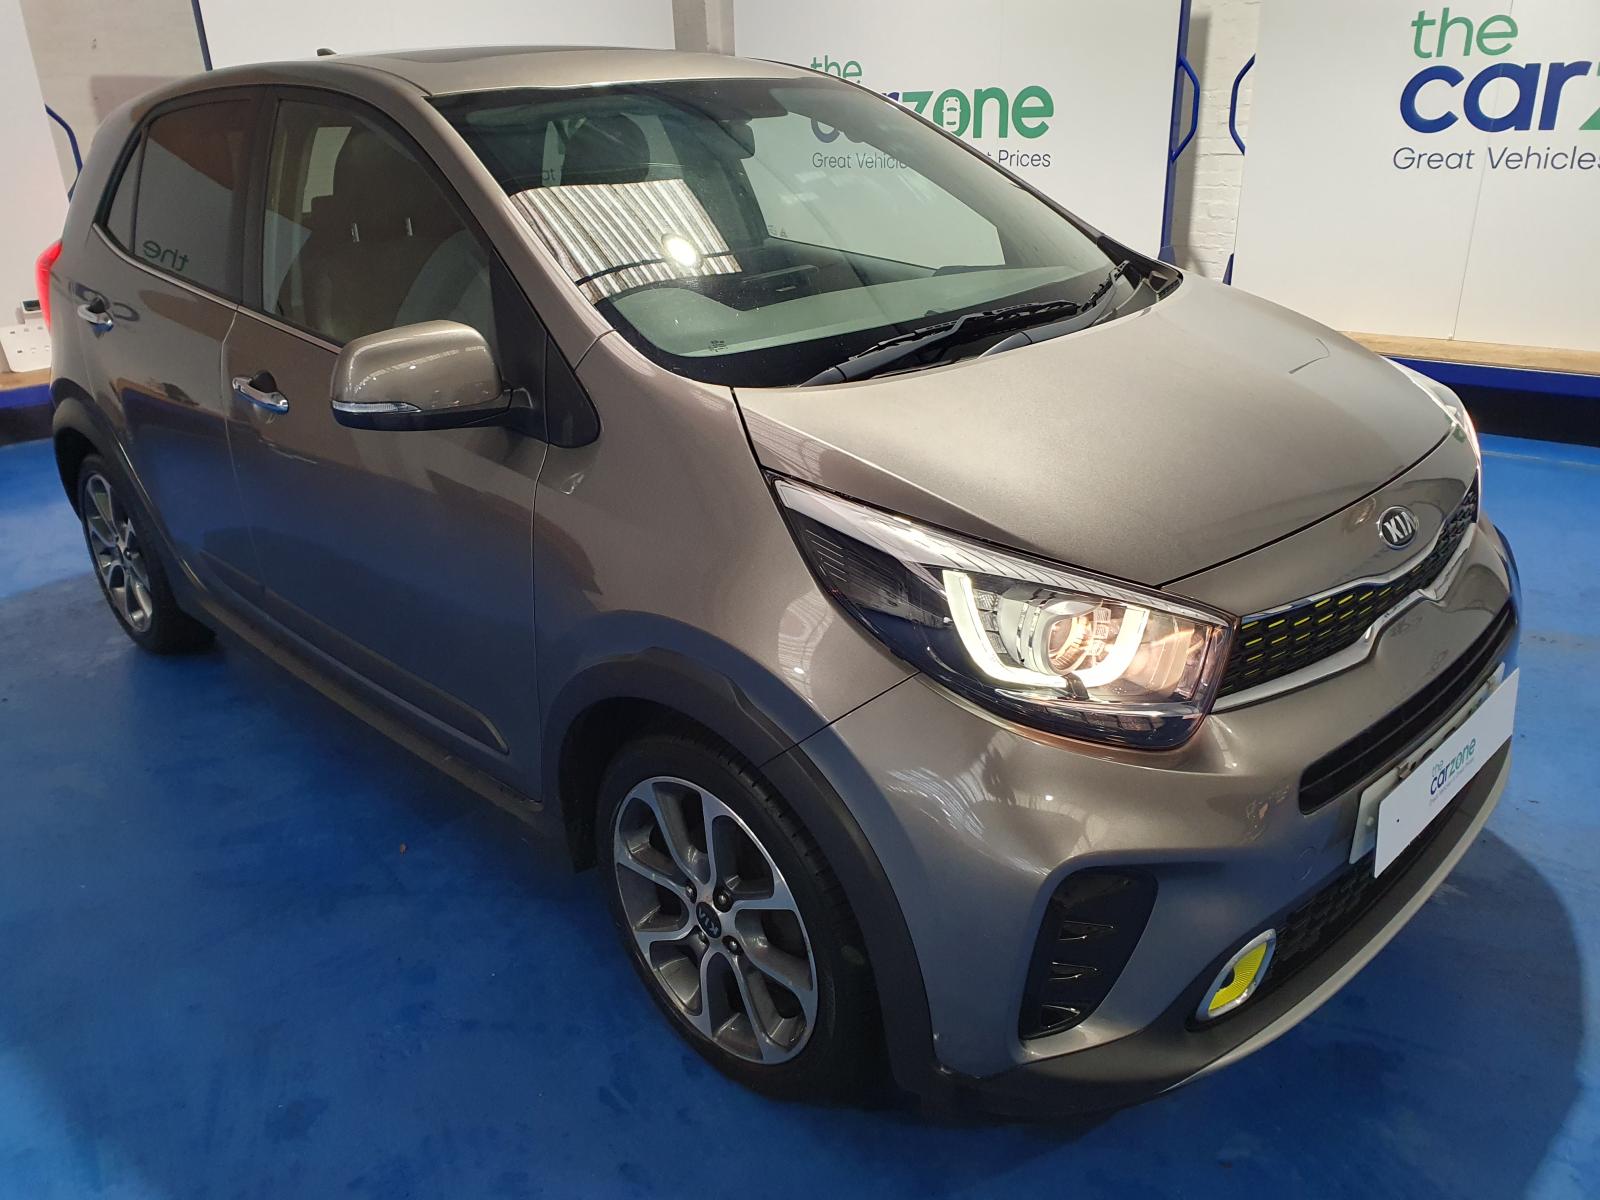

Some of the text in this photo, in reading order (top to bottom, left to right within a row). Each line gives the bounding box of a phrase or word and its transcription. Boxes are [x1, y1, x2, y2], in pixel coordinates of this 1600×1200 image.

[1411, 7, 1518, 59] the
[810, 85, 1054, 143] czone
[812, 149, 1051, 169] Great Vehicl Prices
[1393, 147, 1475, 170] Great
[1383, 511, 1416, 543] KIA
[1430, 738, 1476, 795] carzone
